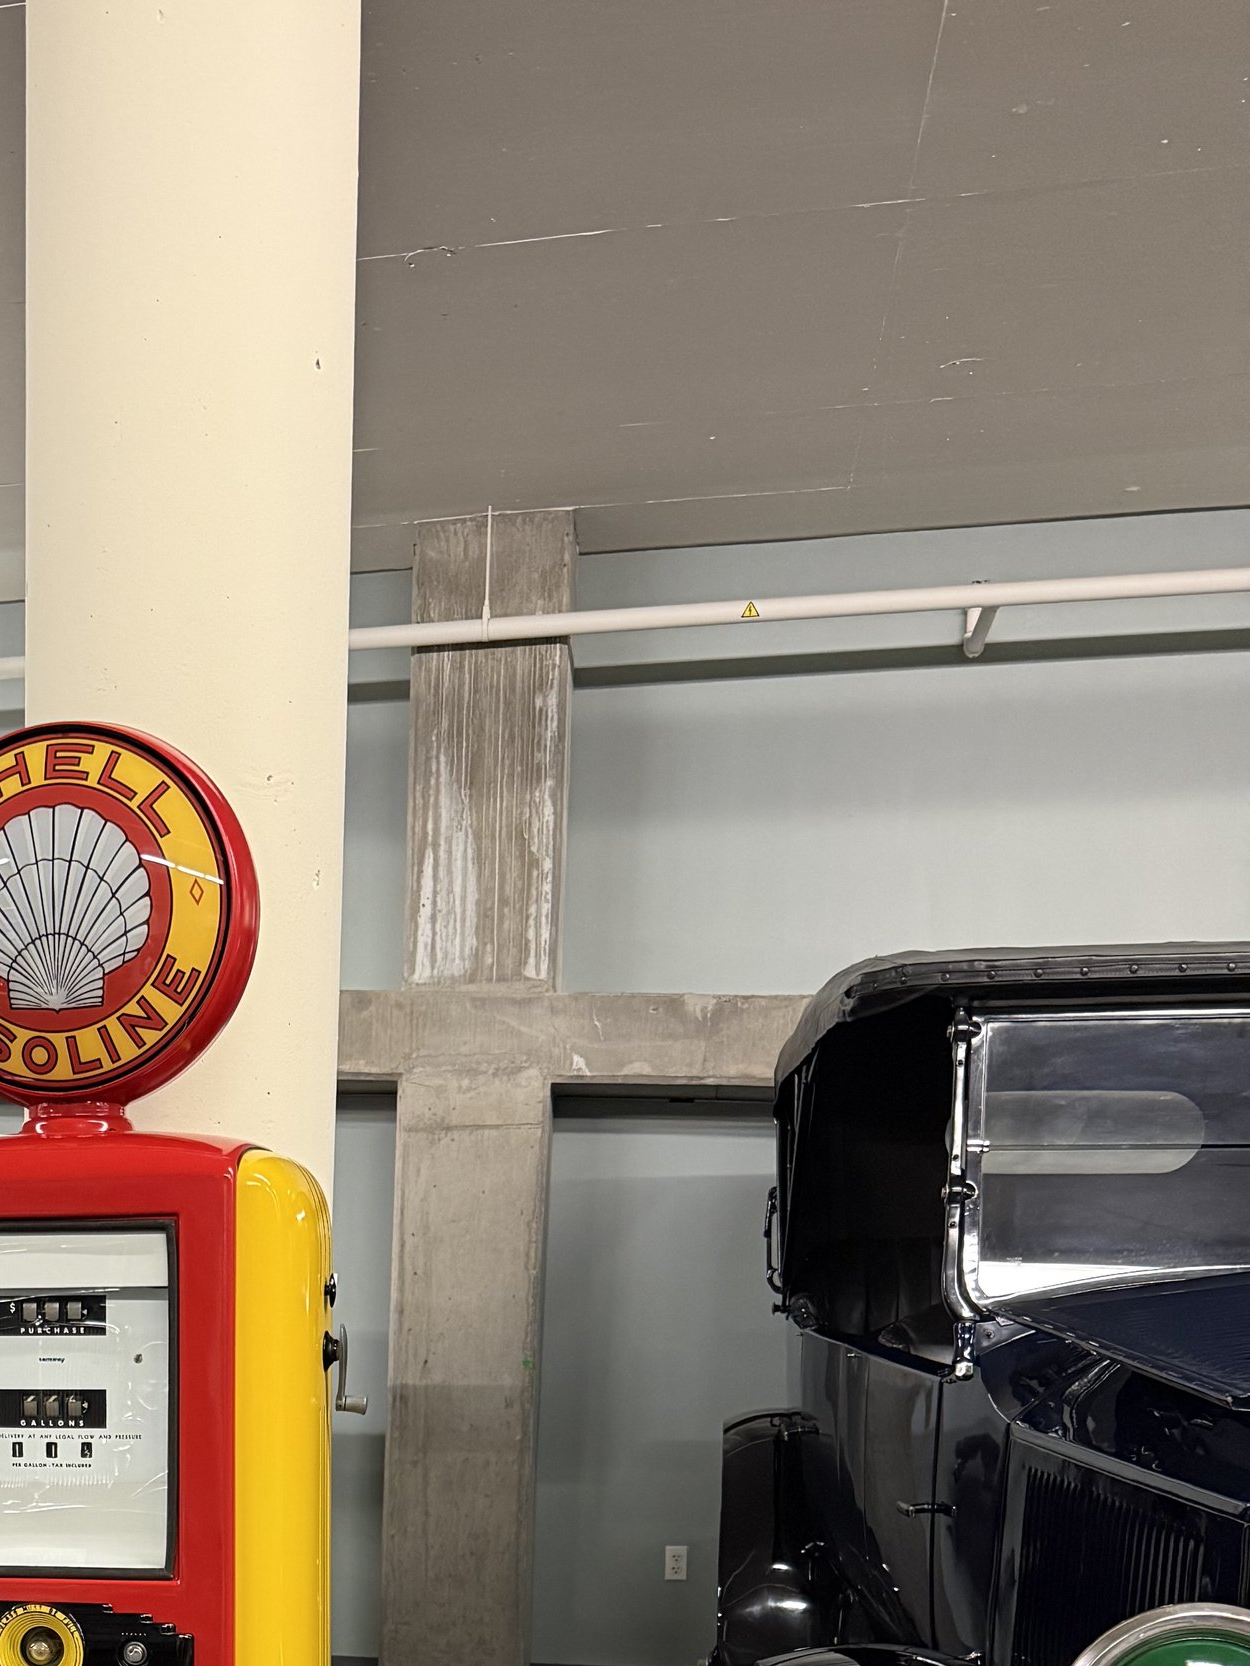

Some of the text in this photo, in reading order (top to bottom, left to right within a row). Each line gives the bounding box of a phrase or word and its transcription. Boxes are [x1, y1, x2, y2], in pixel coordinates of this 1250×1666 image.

[9, 1302, 16, 1314] $
[20, 1327, 85, 1335] PURCHASE
[20, 1419, 85, 1427] GALLONS
